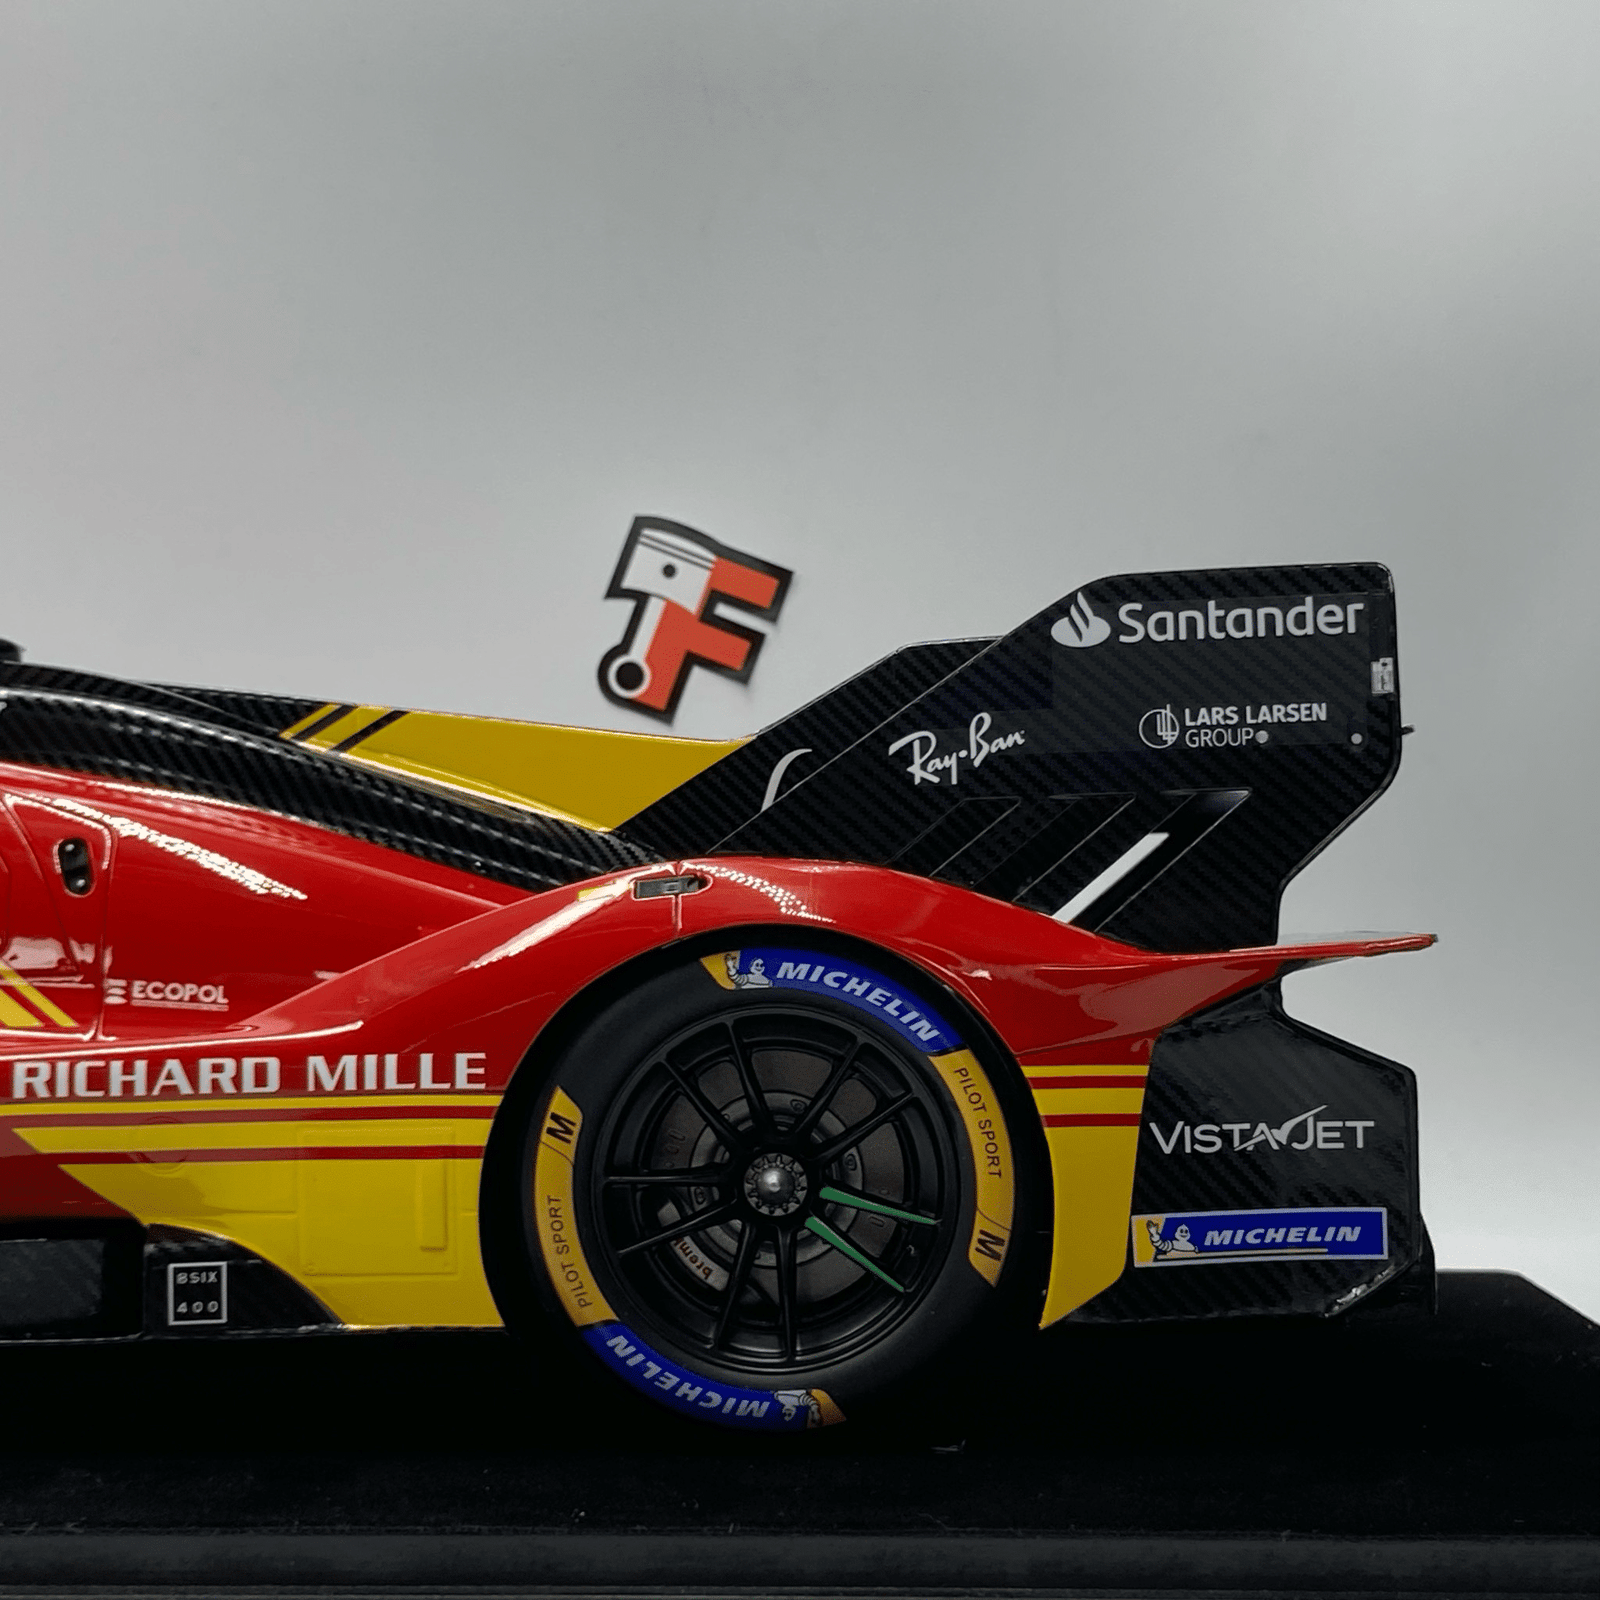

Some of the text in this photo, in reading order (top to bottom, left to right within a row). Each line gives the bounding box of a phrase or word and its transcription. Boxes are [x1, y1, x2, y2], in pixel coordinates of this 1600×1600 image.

[1118, 596, 1364, 644] Santander
[1185, 702, 1327, 726] LARS LARSEN
[1185, 727, 1254, 748] GROUP
[131, 980, 229, 1004] ECOPOL
[776, 962, 940, 1041] MICHELIN
[12, 1052, 487, 1099] RICHARD MILLE
[546, 1111, 576, 1144] M
[954, 1066, 1002, 1179] PILOT SPORT
[547, 1195, 593, 1309] PILOT SPORT
[975, 1229, 1006, 1262] M
[1203, 1226, 1361, 1246] MICHELIN
[176, 1300, 219, 1314] 400
[606, 1335, 771, 1418] MICHELIN
